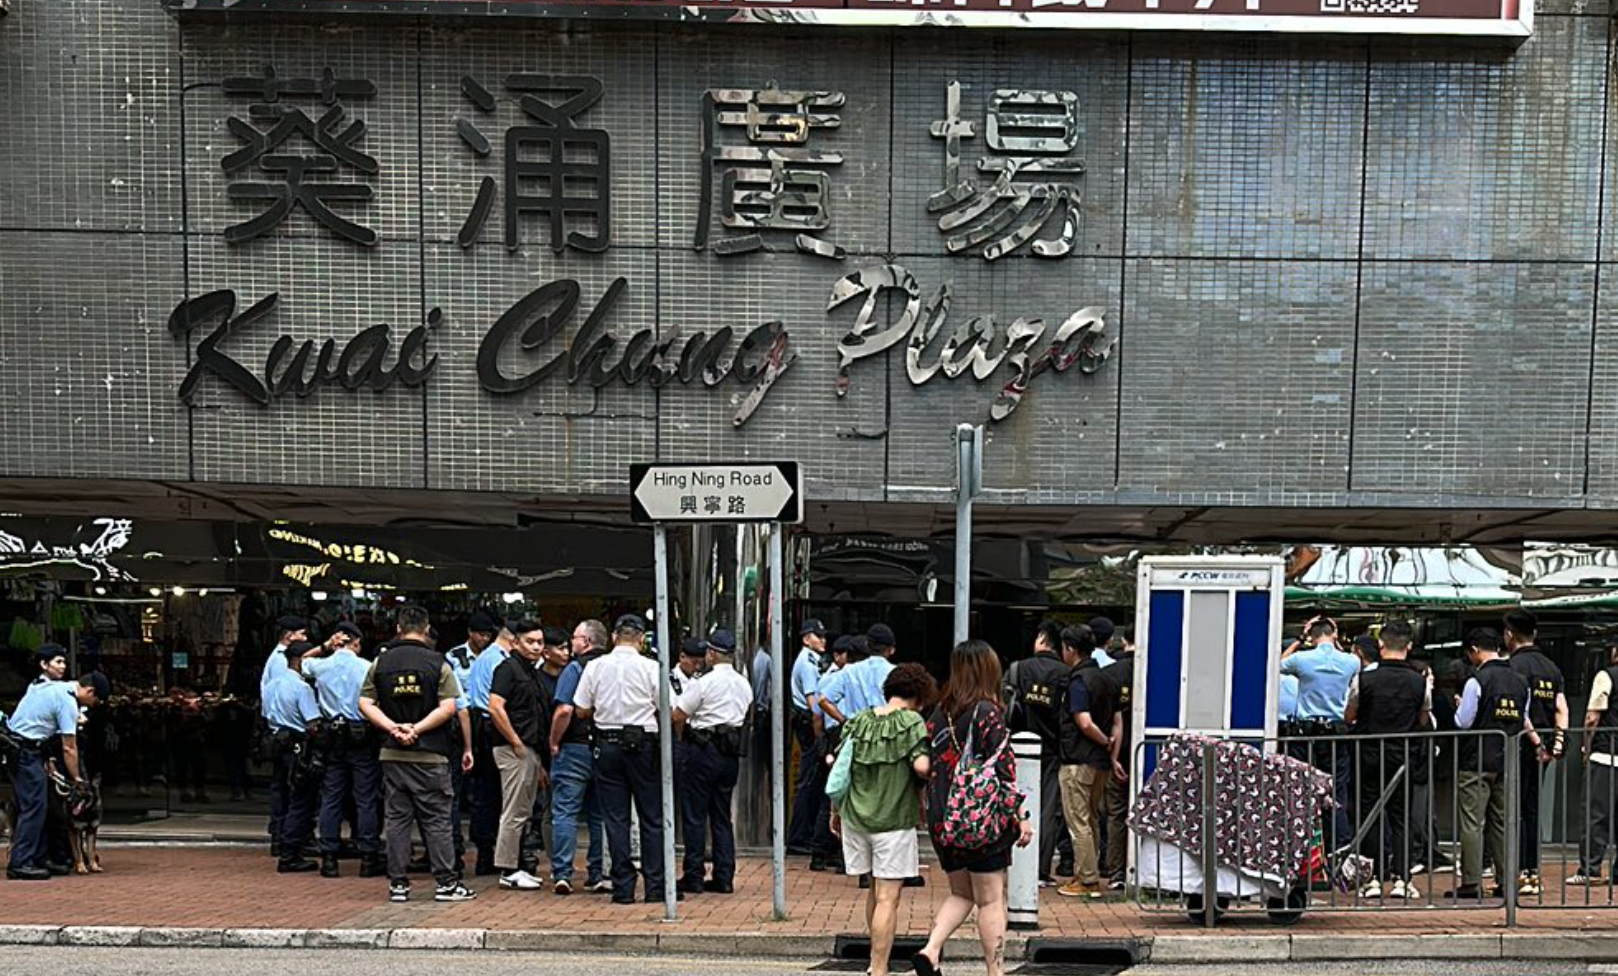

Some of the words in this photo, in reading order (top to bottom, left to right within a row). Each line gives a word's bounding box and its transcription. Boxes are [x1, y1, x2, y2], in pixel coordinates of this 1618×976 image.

[221, 64, 1087, 262] 葵涌廣場
[167, 288, 443, 405] Kwai
[476, 276, 798, 427] Chung
[827, 263, 1118, 421] Plaza
[653, 472, 687, 489] Hing
[691, 470, 725, 489] Ning
[730, 470, 773, 486] Road
[680, 495, 746, 514] 興寧路
[1190, 571, 1220, 580] PCCW
[394, 685, 421, 693] POLICE
[1026, 693, 1051, 704] POLICE
